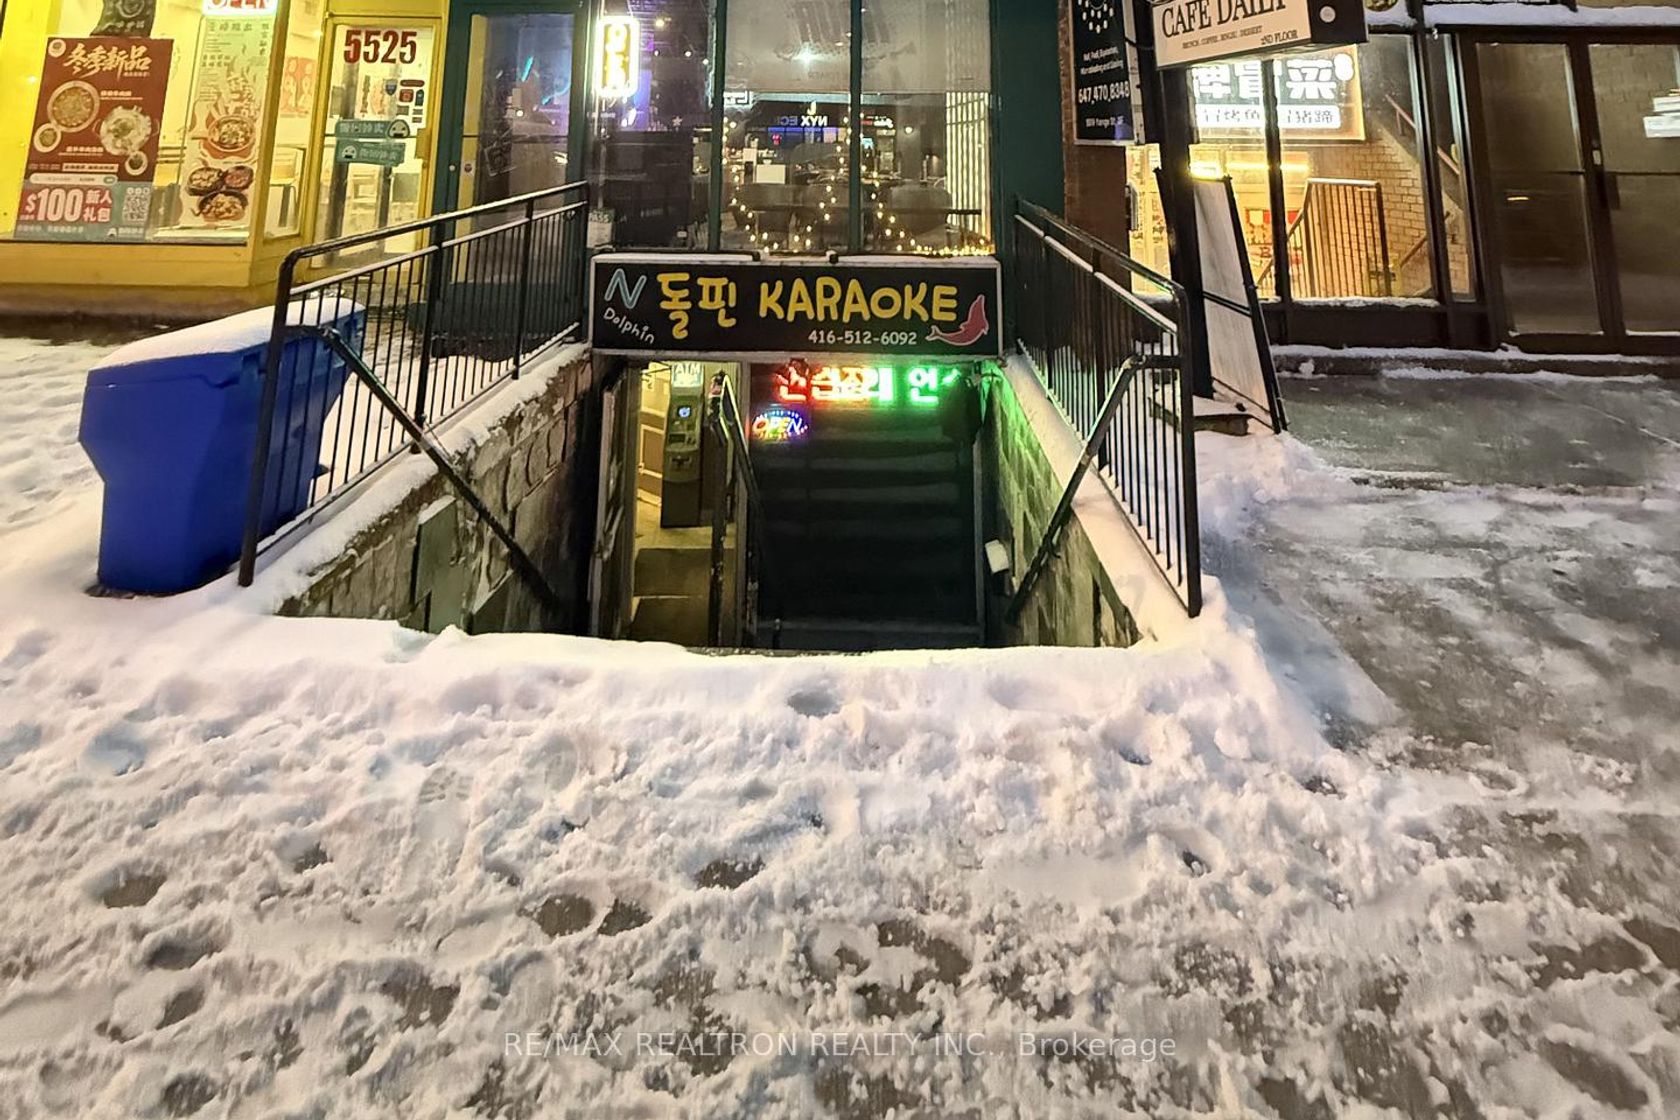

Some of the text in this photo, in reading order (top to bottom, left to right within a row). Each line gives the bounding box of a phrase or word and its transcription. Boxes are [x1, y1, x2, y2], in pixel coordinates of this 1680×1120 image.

[343, 30, 417, 64] 5525
[1275, 30, 1298, 43] FLOOR
[25, 187, 84, 223] $100
[604, 267, 647, 310] N
[657, 271, 737, 340] 돌핀
[759, 276, 958, 323] KARAOKE
[604, 307, 655, 345] Dolphin
[808, 329, 918, 346] 416-512-6092
[752, 416, 804, 436] OPEN
